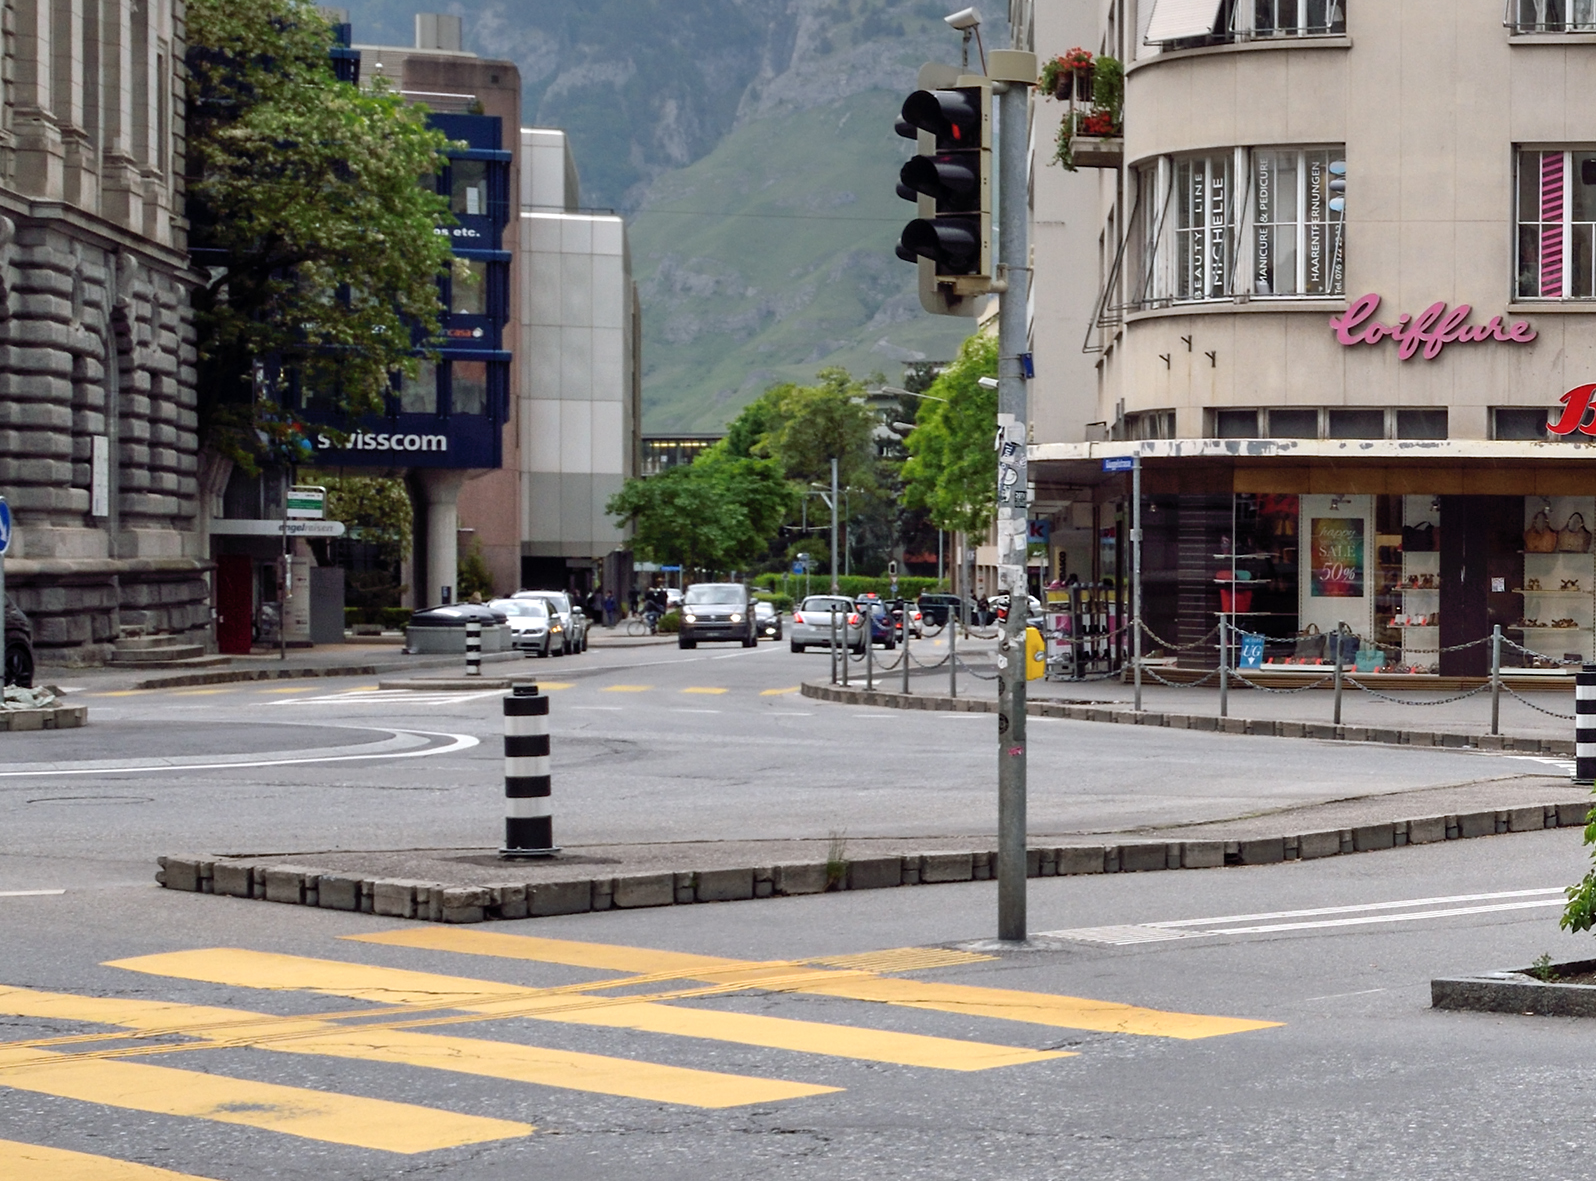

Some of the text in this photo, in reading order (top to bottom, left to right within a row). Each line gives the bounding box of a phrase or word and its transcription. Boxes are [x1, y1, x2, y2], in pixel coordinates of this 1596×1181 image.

[453, 227, 481, 237] etc.
[1194, 173, 1203, 299] BEAUTY LINE
[1212, 178, 1223, 286] MICHELLE
[1259, 157, 1268, 286] MANICURE & PEDICURE
[1311, 161, 1320, 282] HAARENTFERNUNGEN
[1330, 292, 1539, 361] Coiffure
[1318, 545, 1356, 558] SALE
[1319, 562, 1356, 581] 50%
[1243, 645, 1263, 657] UG
